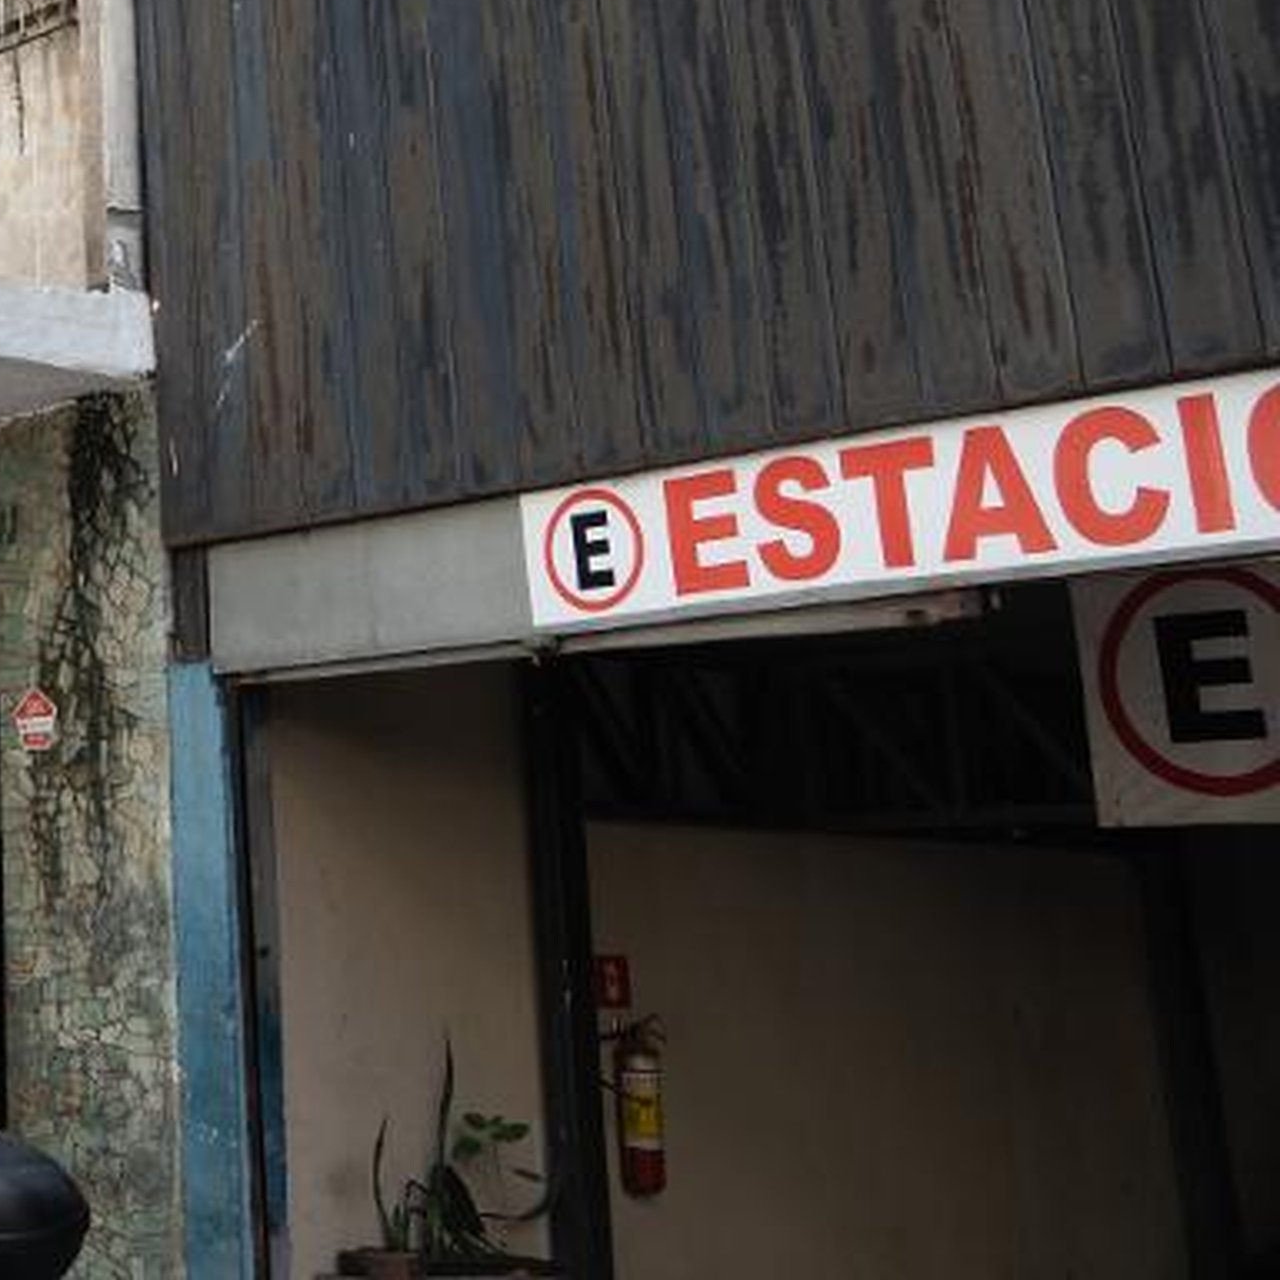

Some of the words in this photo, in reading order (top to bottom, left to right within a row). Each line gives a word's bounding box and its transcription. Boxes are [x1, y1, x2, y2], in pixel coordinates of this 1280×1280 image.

[570, 509, 615, 591] E
[662, 386, 1280, 597] ESTACI
[1153, 608, 1269, 745] E
